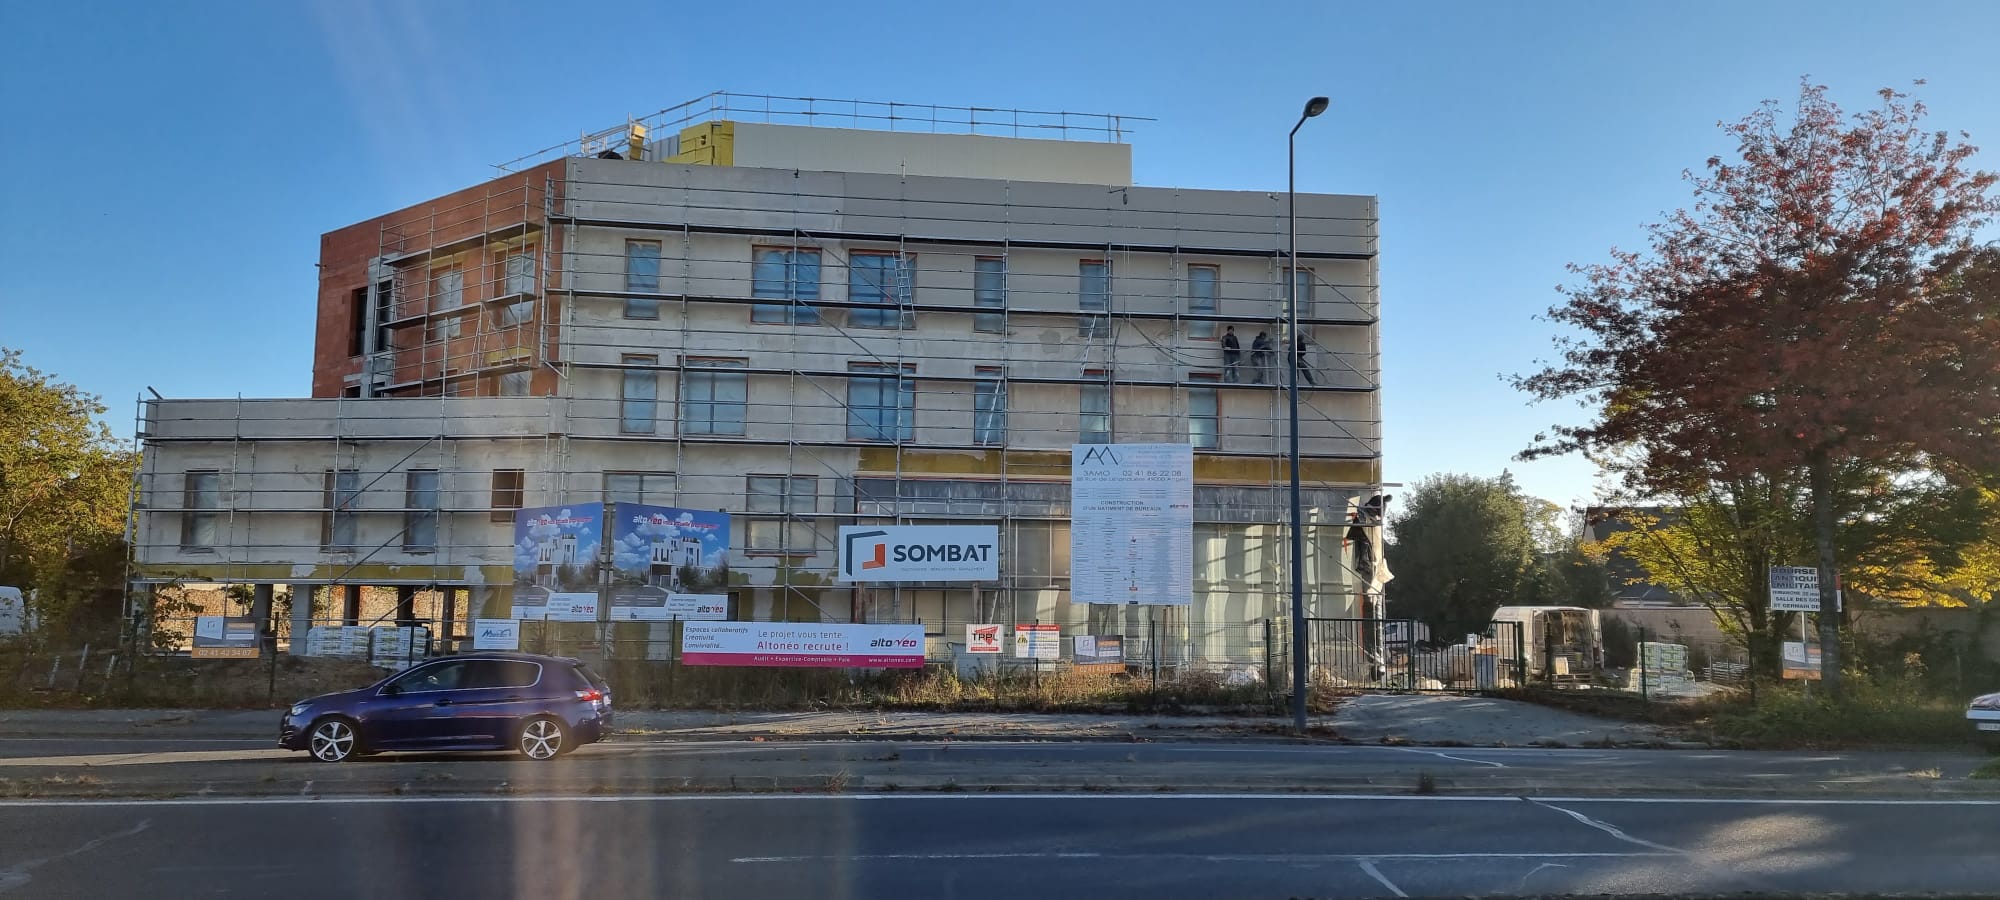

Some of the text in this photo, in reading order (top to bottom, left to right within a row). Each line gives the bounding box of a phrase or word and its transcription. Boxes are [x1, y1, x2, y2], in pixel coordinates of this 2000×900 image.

[894, 544, 992, 562] SOMBAT
[770, 631, 795, 640] projet
[971, 633, 998, 641] TPPL
[758, 640, 849, 651] Altonéo recrute !
